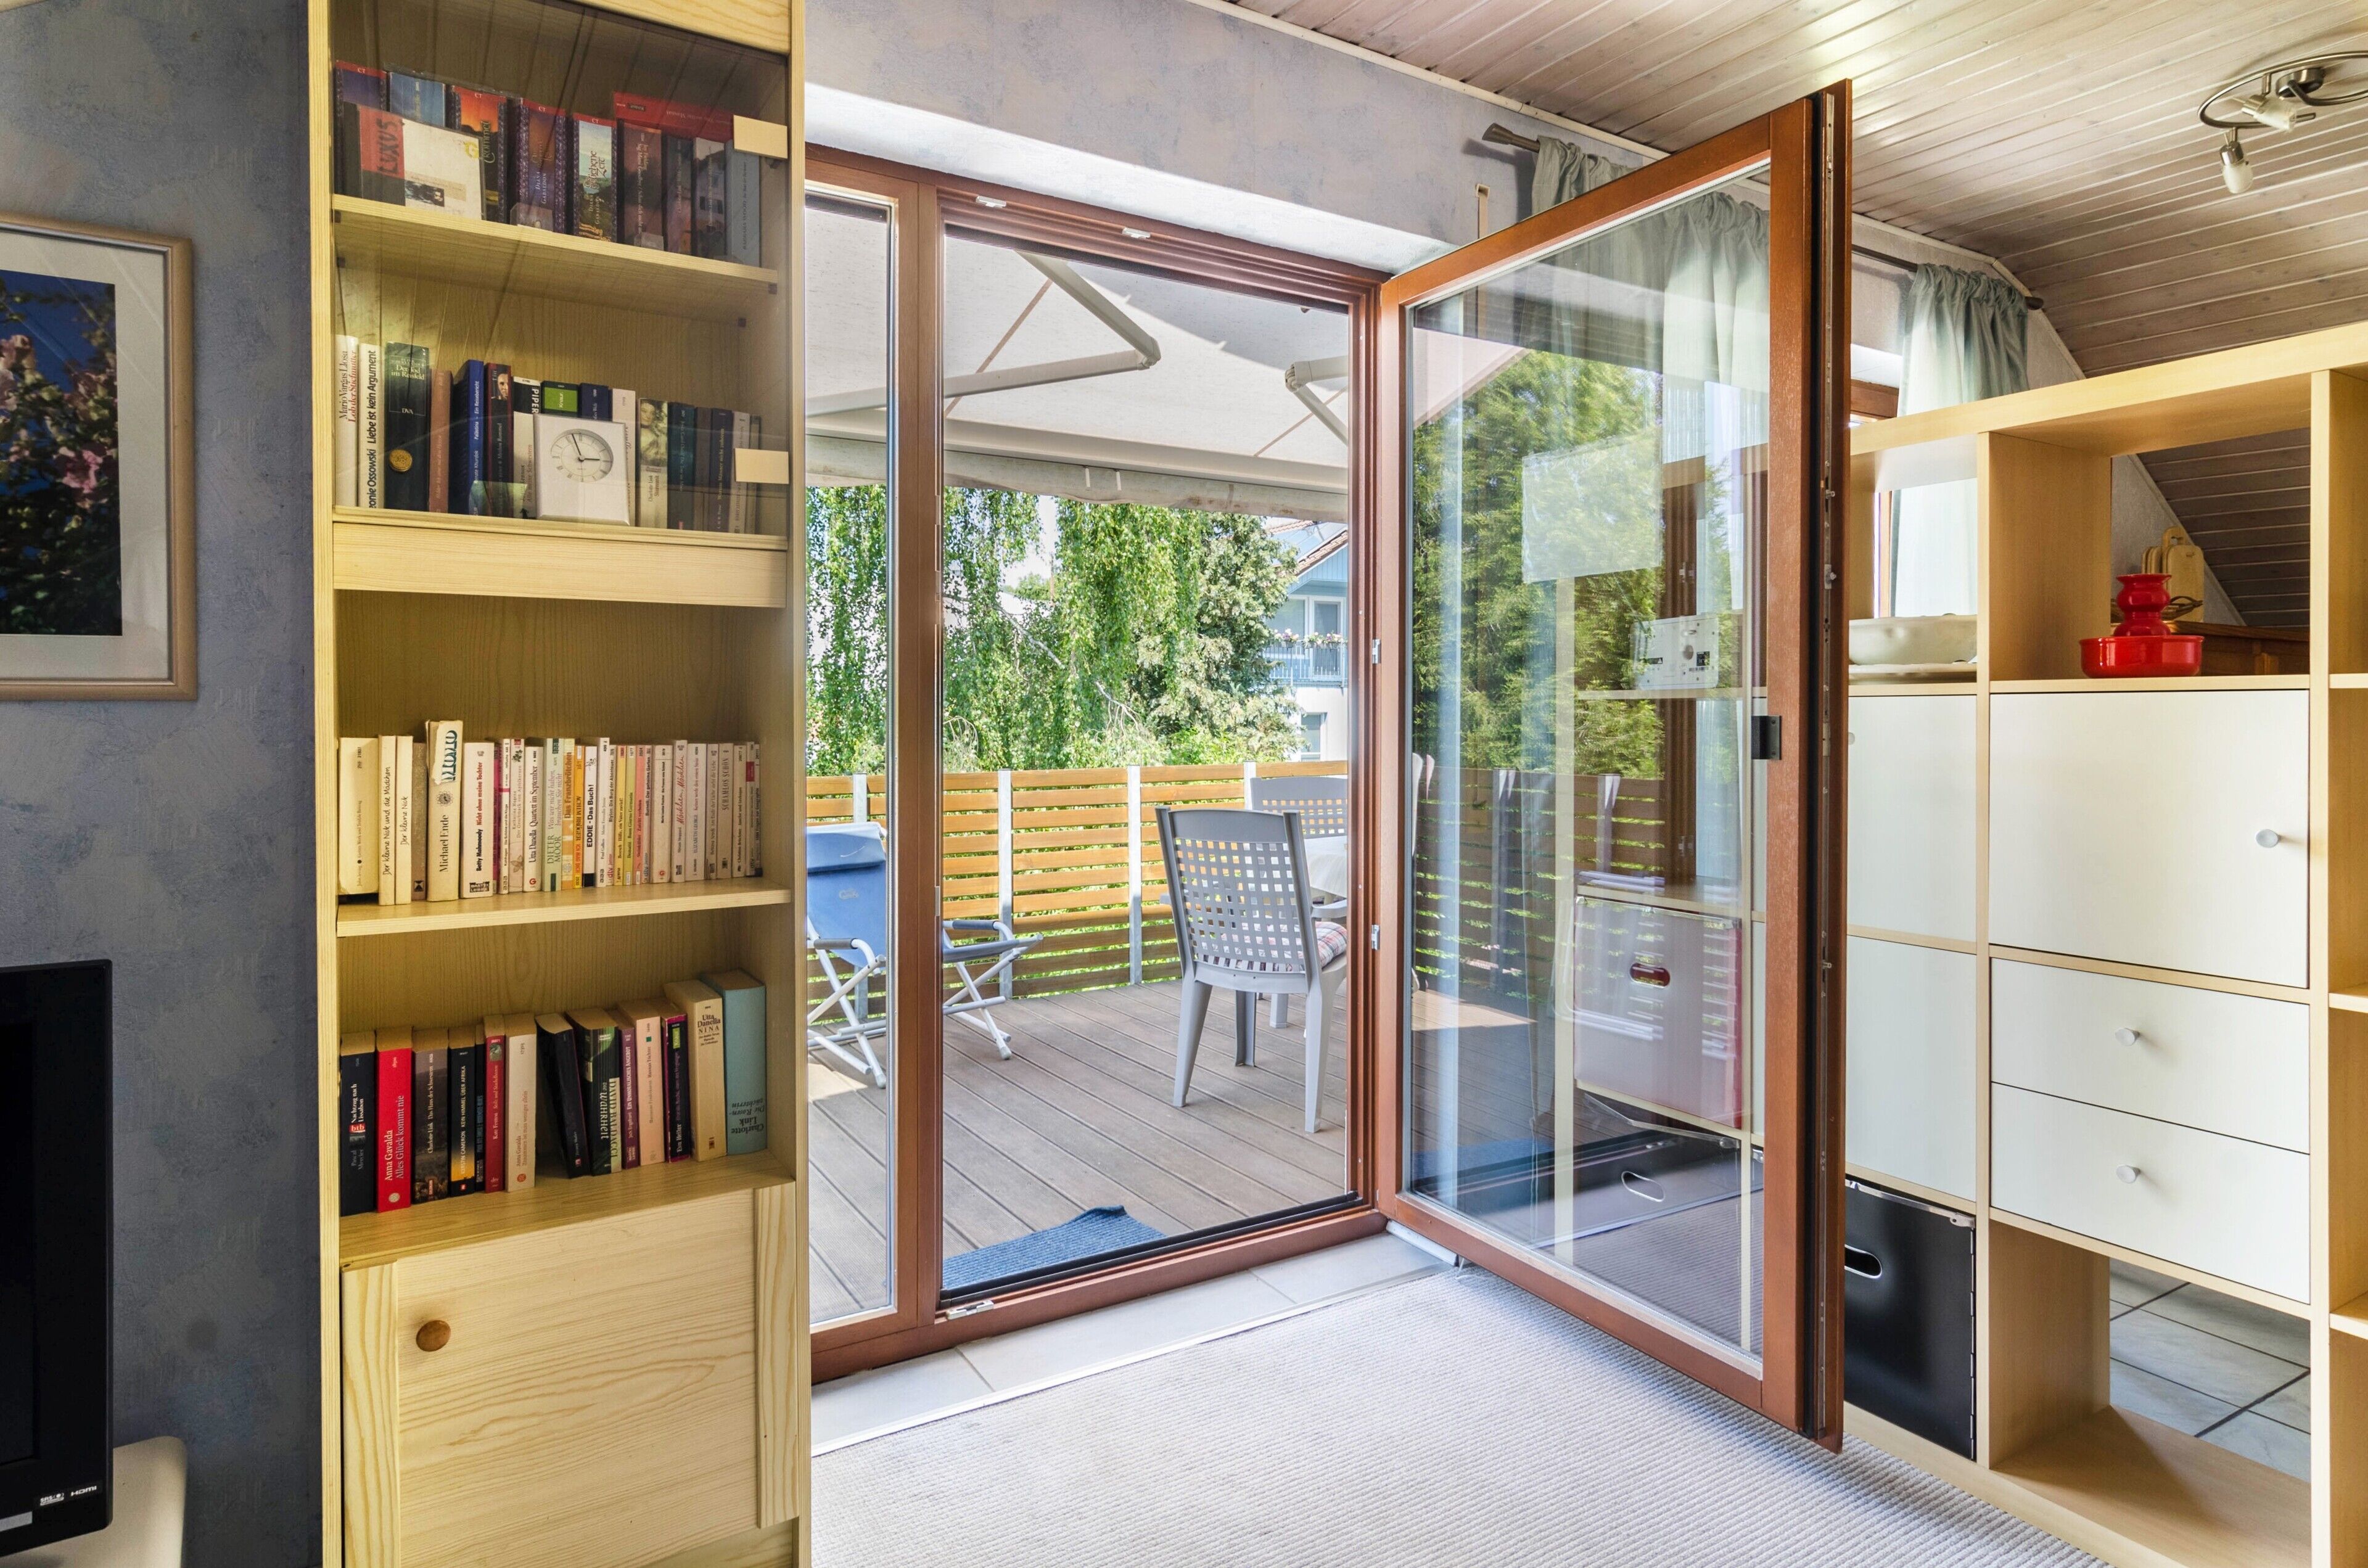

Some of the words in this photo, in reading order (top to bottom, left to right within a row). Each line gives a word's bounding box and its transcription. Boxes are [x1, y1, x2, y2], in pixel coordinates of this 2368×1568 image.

[339, 350, 348, 372] Llosa
[348, 350, 356, 392] Stiefmutter
[367, 350, 378, 392] Argument
[339, 373, 348, 396] Vargas
[339, 396, 348, 419] Mario
[348, 392, 356, 406] der
[366, 392, 376, 409] kein
[532, 388, 540, 413] PIPER
[348, 406, 356, 422] Lob
[367, 411, 376, 420] ist
[366, 421, 376, 444] Liebe
[366, 448, 376, 486] Ossowski
[382, 766, 391, 795] Mädchen
[529, 765, 539, 795] September
[548, 770, 556, 789] haben,
[675, 755, 685, 789] Mädchen
[382, 797, 390, 807] die
[400, 796, 408, 810] Nick
[530, 795, 537, 803] im
[722, 779, 730, 811] SCHAMLOS
[382, 809, 390, 824] und
[399, 811, 408, 832] kleine
[529, 804, 538, 827] Quartett
[382, 826, 390, 840] Nick
[439, 815, 450, 838] Ende
[400, 835, 409, 845] Der
[475, 829, 483, 857] Mahmoody
[528, 829, 537, 850] Danella
[382, 840, 390, 862] kleine
[438, 839, 450, 872] Michael
[528, 850, 537, 863] Utta
[382, 864, 392, 876] Der
[697, 1018, 721, 1028] Danella
[397, 1096, 405, 1107] nie
[610, 1081, 618, 1109] DAVID
[350, 1098, 358, 1124] Nachtzug
[754, 1105, 765, 1113] Die
[350, 1124, 364, 1132] btb
[396, 1109, 405, 1136] kommt
[731, 1123, 765, 1135] Charlotte
[739, 1117, 757, 1127] Link
[384, 1130, 393, 1161] Gavalda
[396, 1137, 405, 1160] Glück
[384, 1162, 393, 1181] Anna
[396, 1162, 404, 1180] Alles
